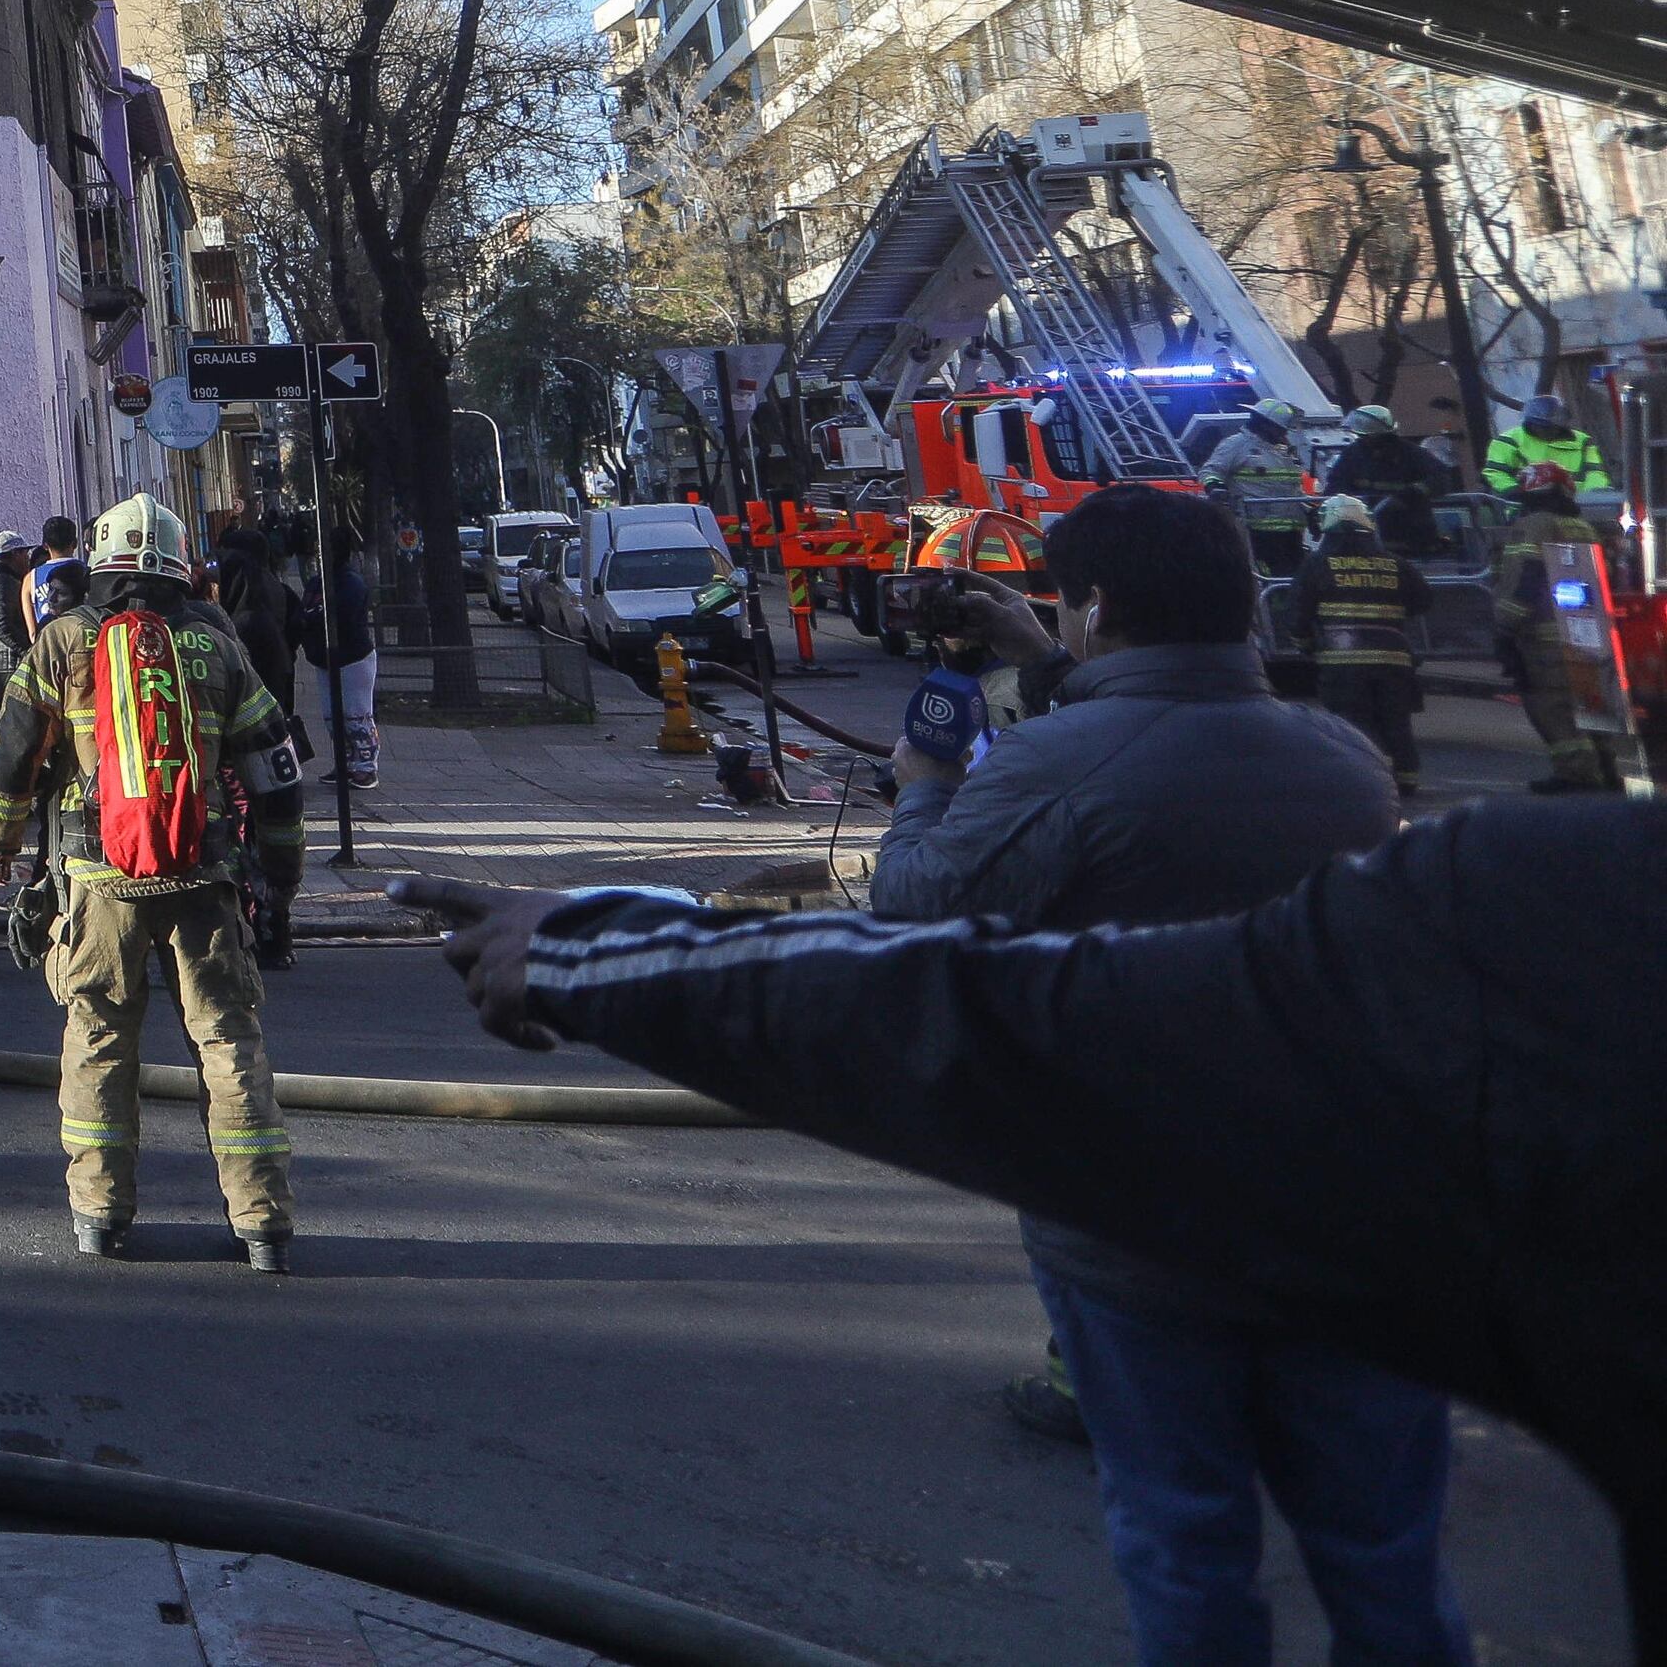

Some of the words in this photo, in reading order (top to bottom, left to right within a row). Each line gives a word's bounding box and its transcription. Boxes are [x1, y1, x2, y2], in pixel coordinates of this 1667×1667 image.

[193, 351, 257, 365] GRAJALES
[193, 386, 219, 399] 1902
[275, 386, 301, 398] 1990
[101, 522, 110, 542] 8
